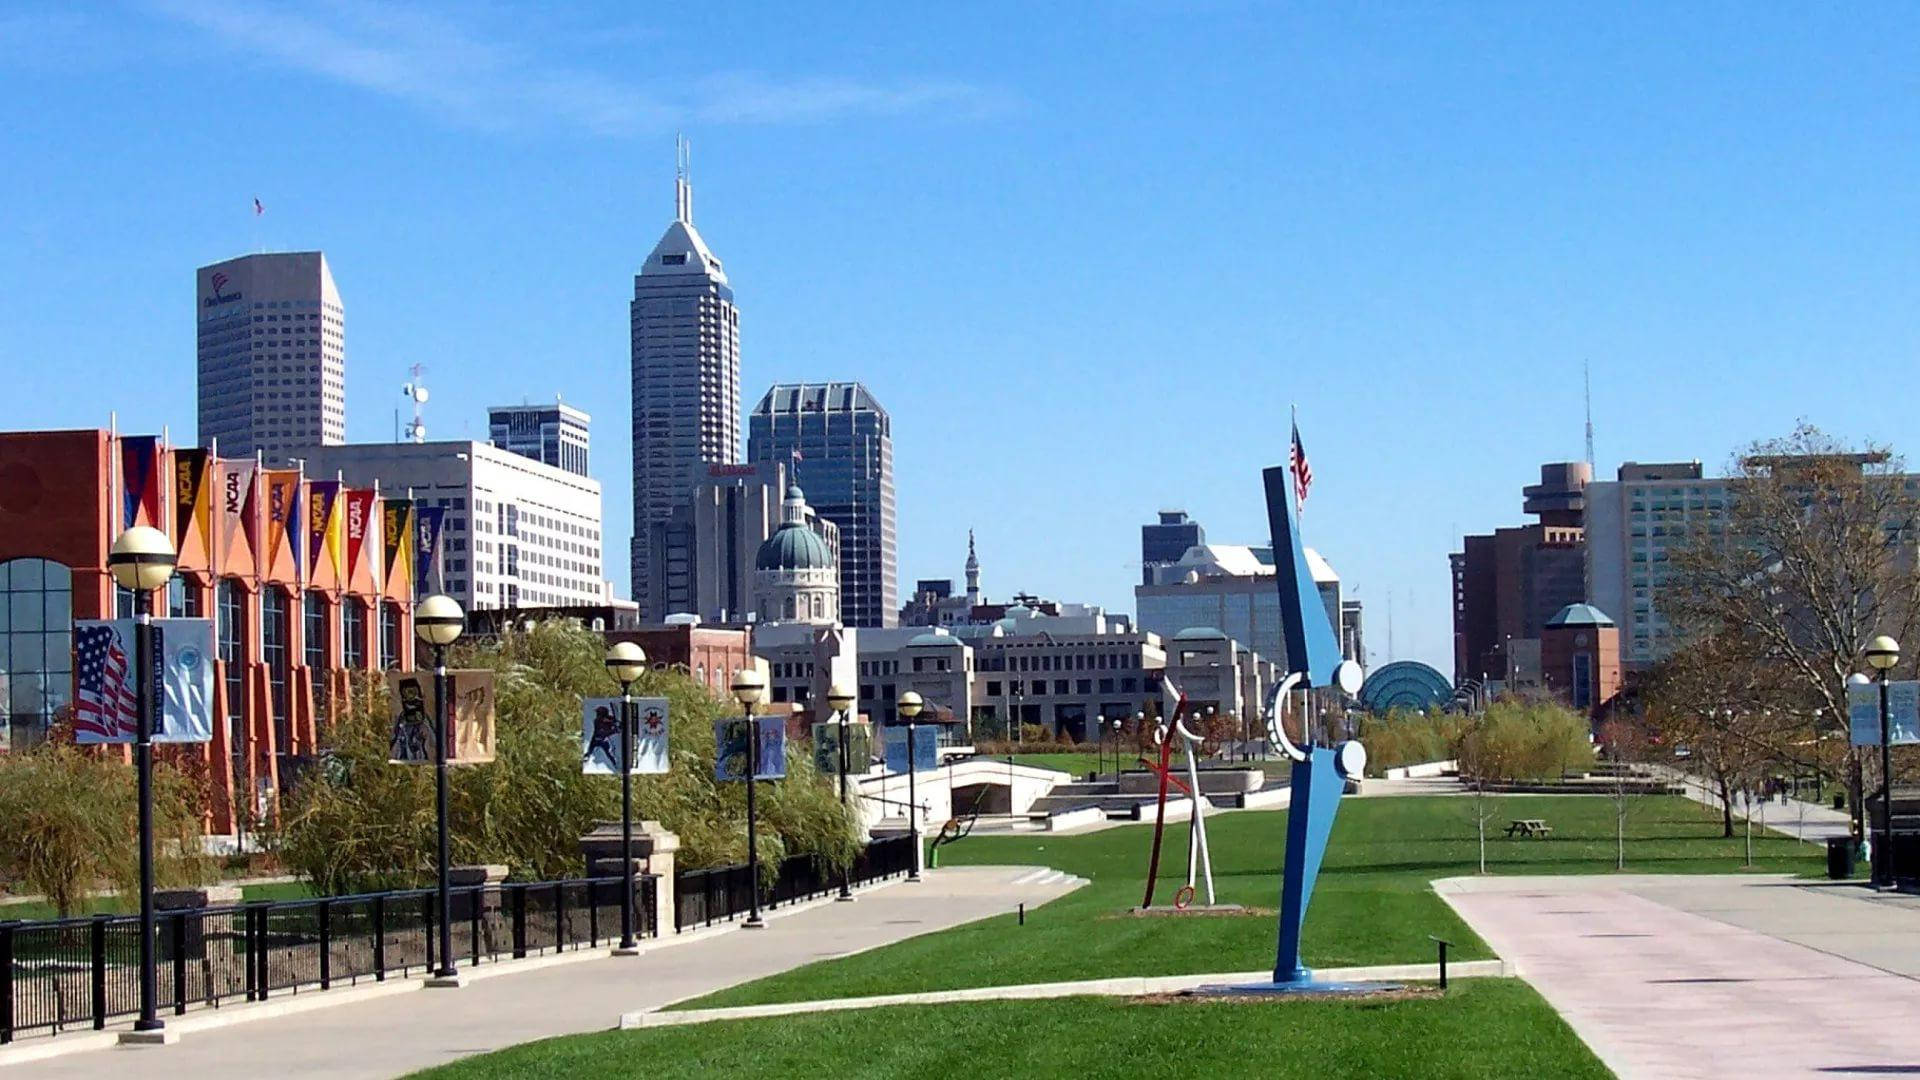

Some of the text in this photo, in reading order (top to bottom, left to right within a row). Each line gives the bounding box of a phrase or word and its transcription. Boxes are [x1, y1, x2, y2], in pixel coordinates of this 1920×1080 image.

[179, 460, 192, 505] NCAA
[226, 472, 239, 513] NCAA
[350, 498, 362, 539] NCAA
